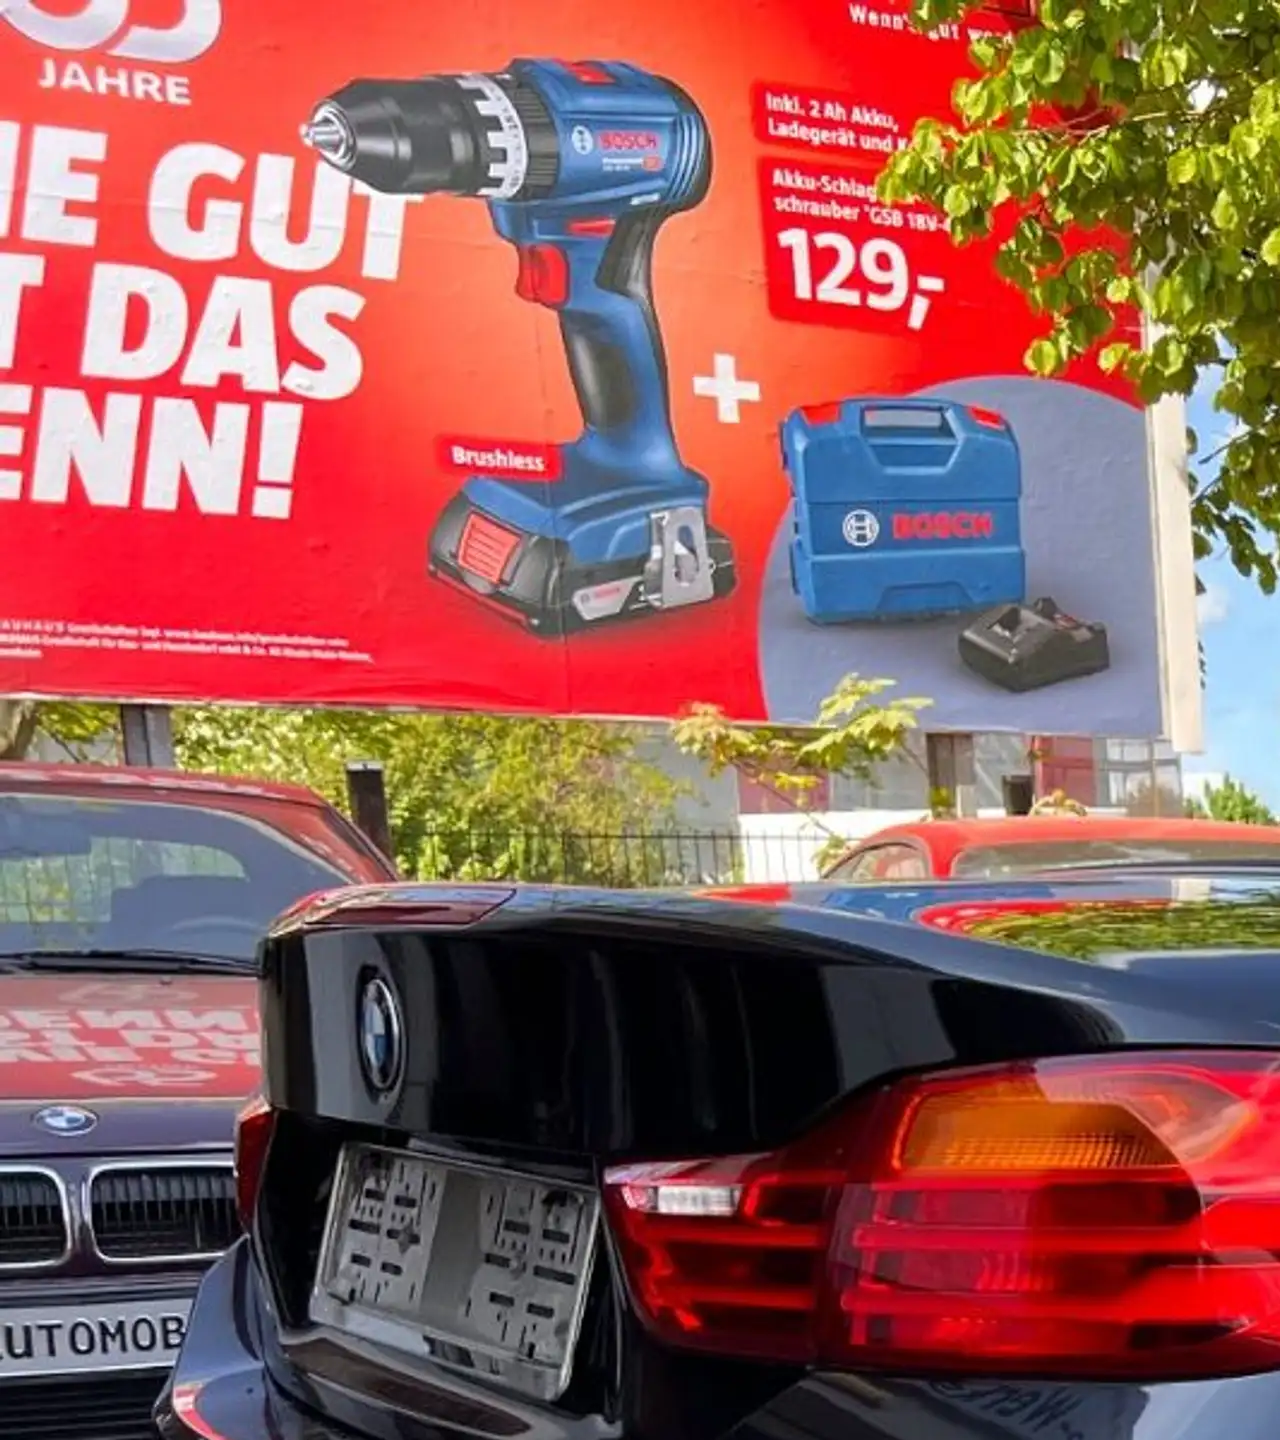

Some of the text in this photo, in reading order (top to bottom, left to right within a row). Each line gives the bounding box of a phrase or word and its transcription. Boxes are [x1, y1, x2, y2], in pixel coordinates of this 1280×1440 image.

[38, 57, 192, 106] JAHRE
[765, 92, 899, 132] Inkl. 2 Ah Akku,
[768, 117, 855, 146] Ladegerät
[860, 137, 893, 153] und
[147, 142, 424, 281] GUT
[775, 195, 859, 221] schrauber
[777, 228, 945, 331] 129,-
[80, 262, 367, 401] DAS
[452, 445, 545, 472] Brushless
[893, 511, 993, 539] BOSCH
[0, 1312, 185, 1360] UTOMOB
